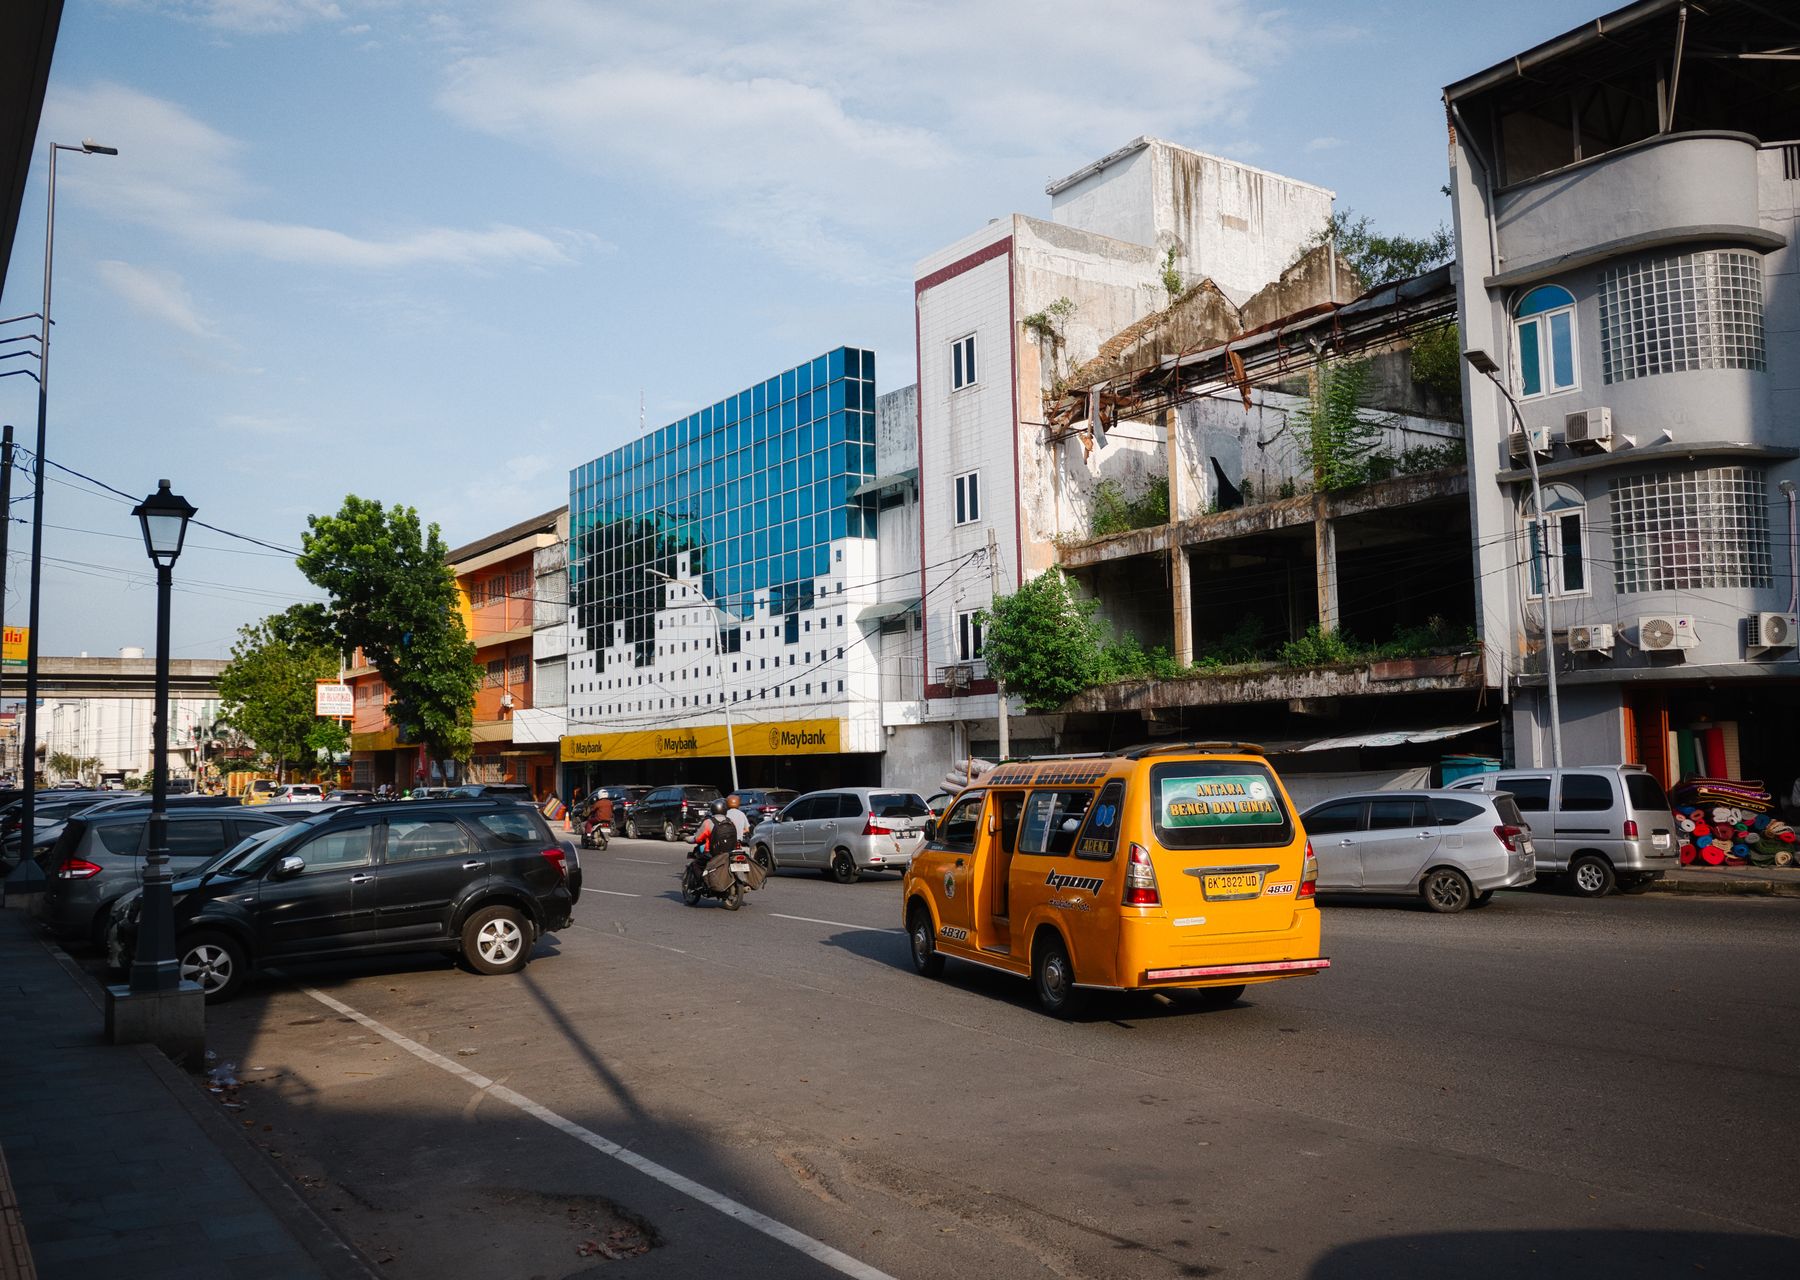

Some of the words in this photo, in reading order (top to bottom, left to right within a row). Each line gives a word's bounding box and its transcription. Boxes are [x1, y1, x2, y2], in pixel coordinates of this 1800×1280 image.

[663, 737, 698, 754] Maybank
[781, 729, 826, 749] Maybank
[576, 741, 602, 756] Maybank
[1035, 762, 1113, 785] GROUP
[1196, 783, 1247, 797] ANTARA
[1170, 802, 1210, 817] BENCI
[1212, 801, 1237, 814] DAN
[1239, 800, 1274, 814] CINTA
[1208, 878, 1219, 889] BK
[1221, 876, 1243, 888] 1822
[1267, 884, 1293, 894] 4830
[940, 926, 967, 941] 4830
